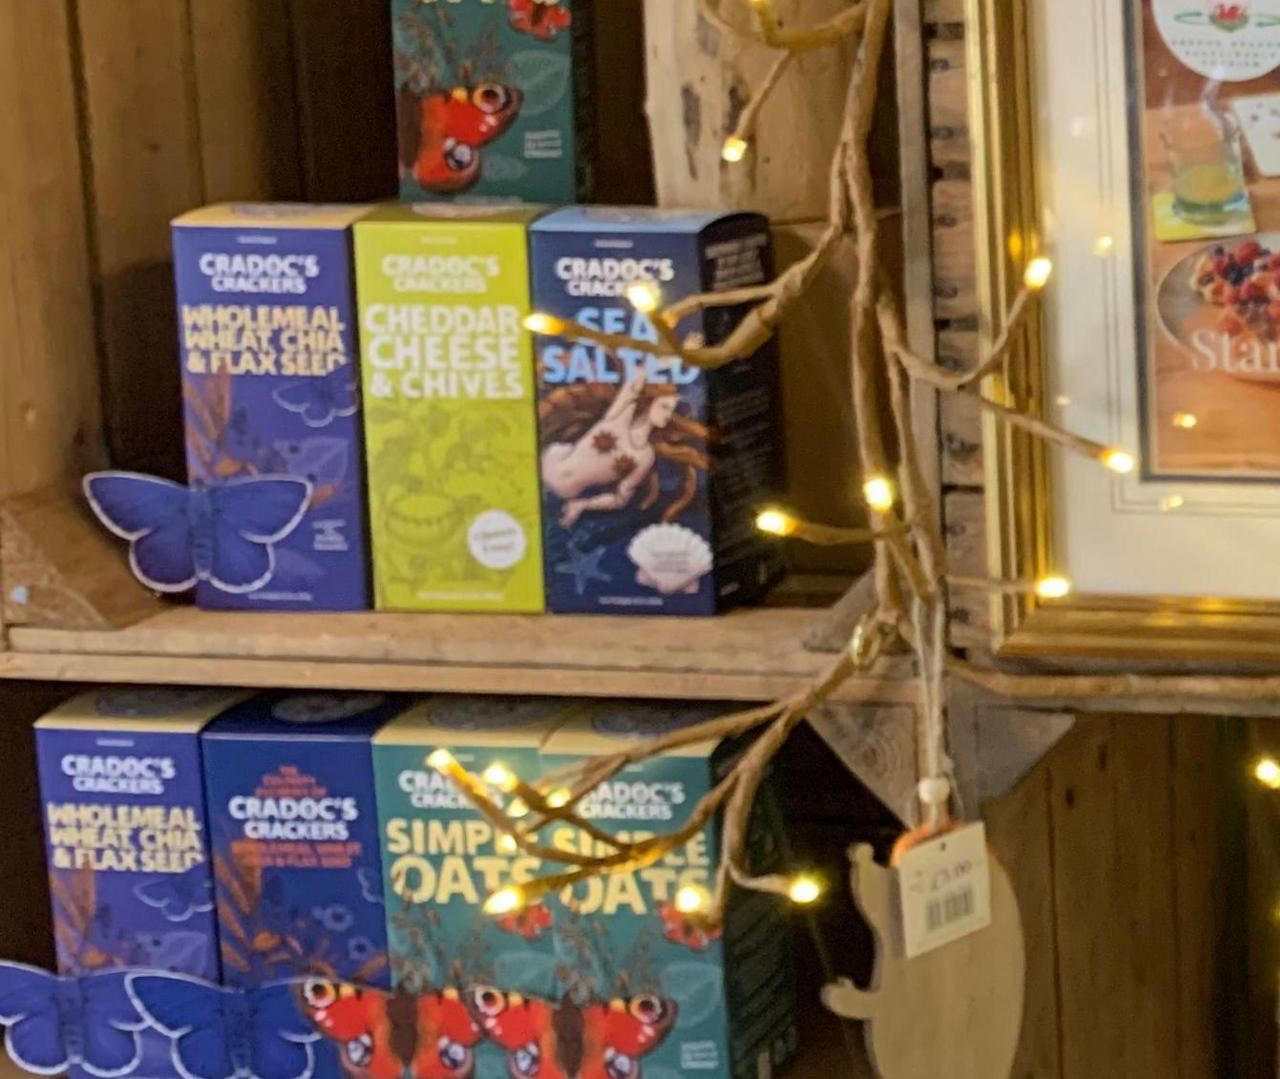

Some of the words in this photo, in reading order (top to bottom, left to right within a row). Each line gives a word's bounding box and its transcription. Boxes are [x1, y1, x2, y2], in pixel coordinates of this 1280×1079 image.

[199, 252, 319, 278] CRADOC'S
[380, 255, 500, 278] CRADOC'S
[556, 257, 675, 281] CRADOC'S
[211, 276, 307, 294] CRACKERS
[394, 275, 488, 293] CRACKERS
[182, 304, 345, 332] WHOLEMEAL
[365, 304, 521, 335] CHEDDAR
[184, 328, 271, 351] WHEAT
[279, 330, 346, 354] CHIA
[368, 336, 521, 370] CHEESE
[186, 352, 206, 374] &
[210, 351, 277, 375] FLAX
[369, 373, 394, 399] &
[401, 370, 526, 399] CHIVES
[61, 753, 176, 780] CRADOC'S
[73, 777, 165, 795] CRACKERS
[47, 801, 201, 830] WHOLEMEAL
[228, 795, 359, 821] CRADOC'S
[577, 803, 673, 820] CRACKERS
[50, 825, 133, 850] WHEAT
[139, 827, 203, 851] CHIA
[243, 820, 350, 841] CRACKERS
[53, 847, 71, 869] &
[76, 848, 136, 871] FLAX
